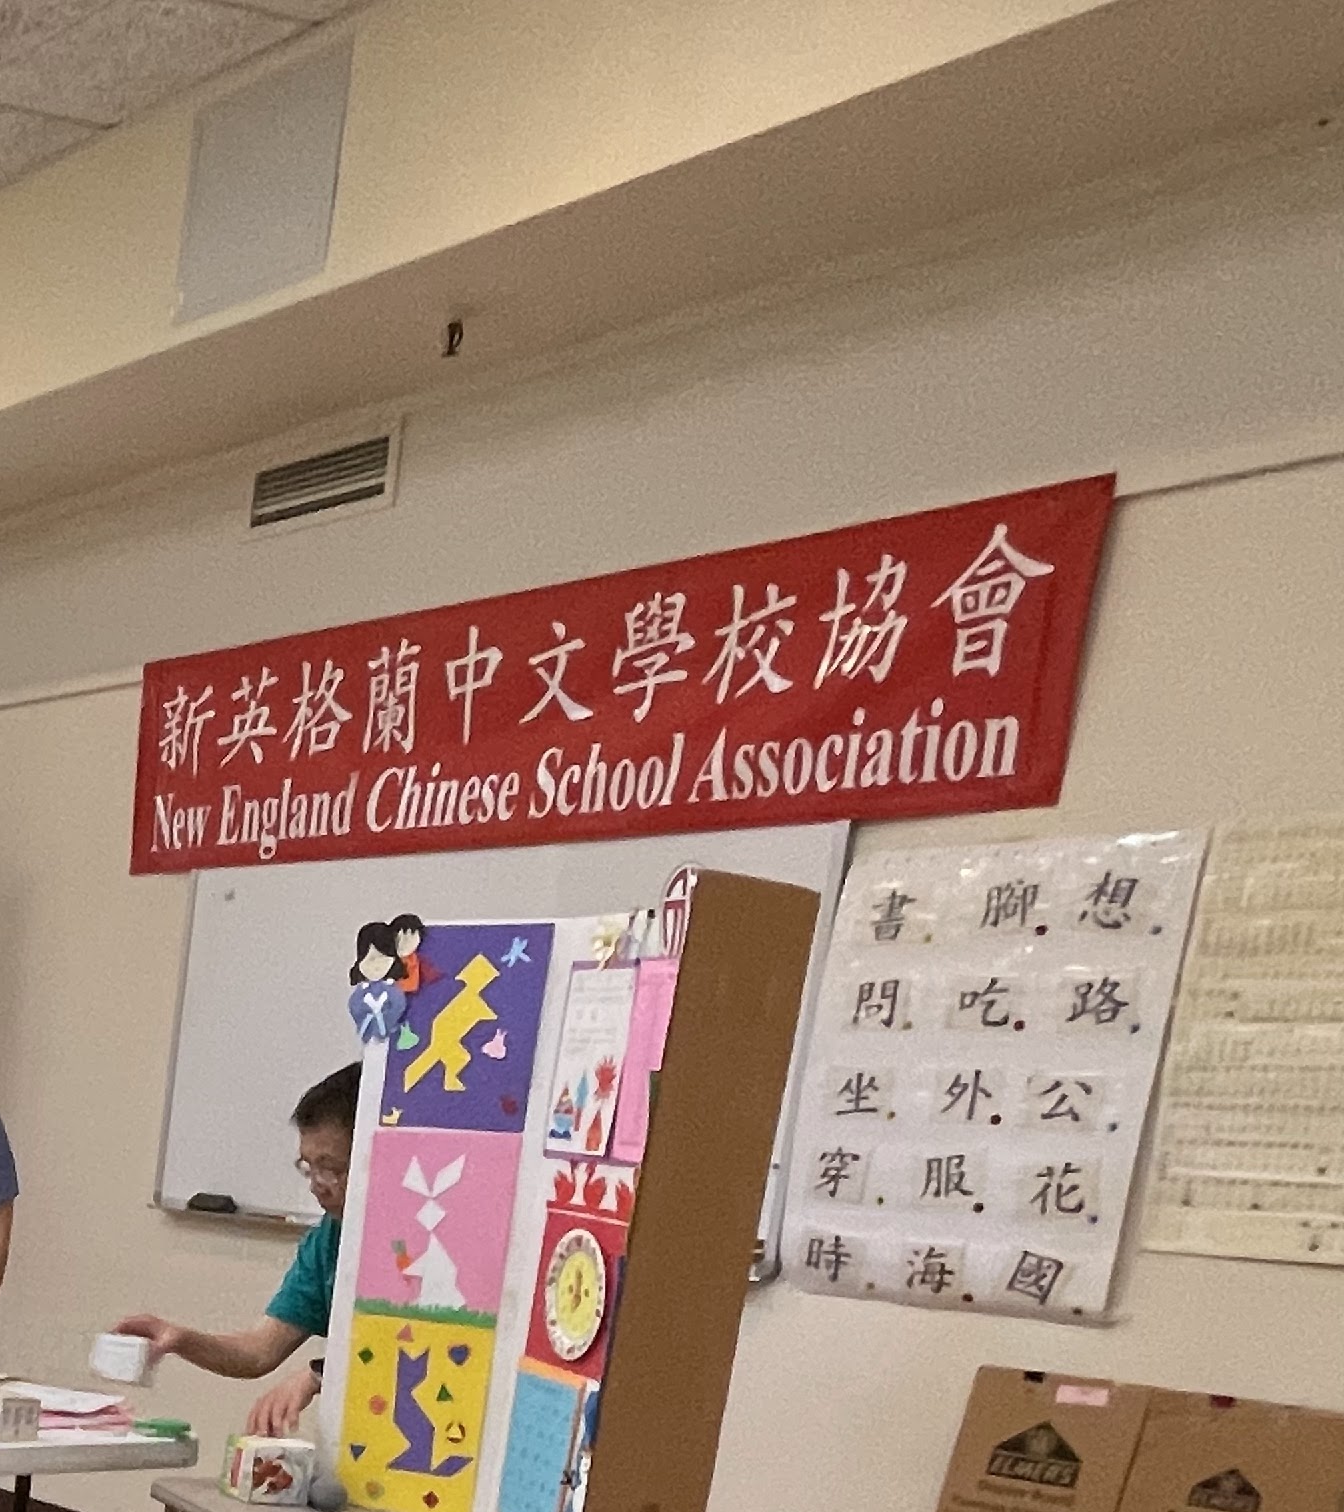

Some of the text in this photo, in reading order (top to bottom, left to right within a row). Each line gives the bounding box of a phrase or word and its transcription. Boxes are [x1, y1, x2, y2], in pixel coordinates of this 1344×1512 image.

[157, 521, 1056, 776] 新英格蘭中文學校協會
[150, 696, 1020, 860] New England Chinese School Association
[871, 888, 917, 942] 書
[1078, 871, 1139, 930] 想
[852, 975, 1130, 1029] 問 吃 路
[835, 1069, 1093, 1123] 坐 外 公
[815, 1147, 1085, 1215] 穿 服 花
[805, 1236, 1064, 1306] 時 海 國
